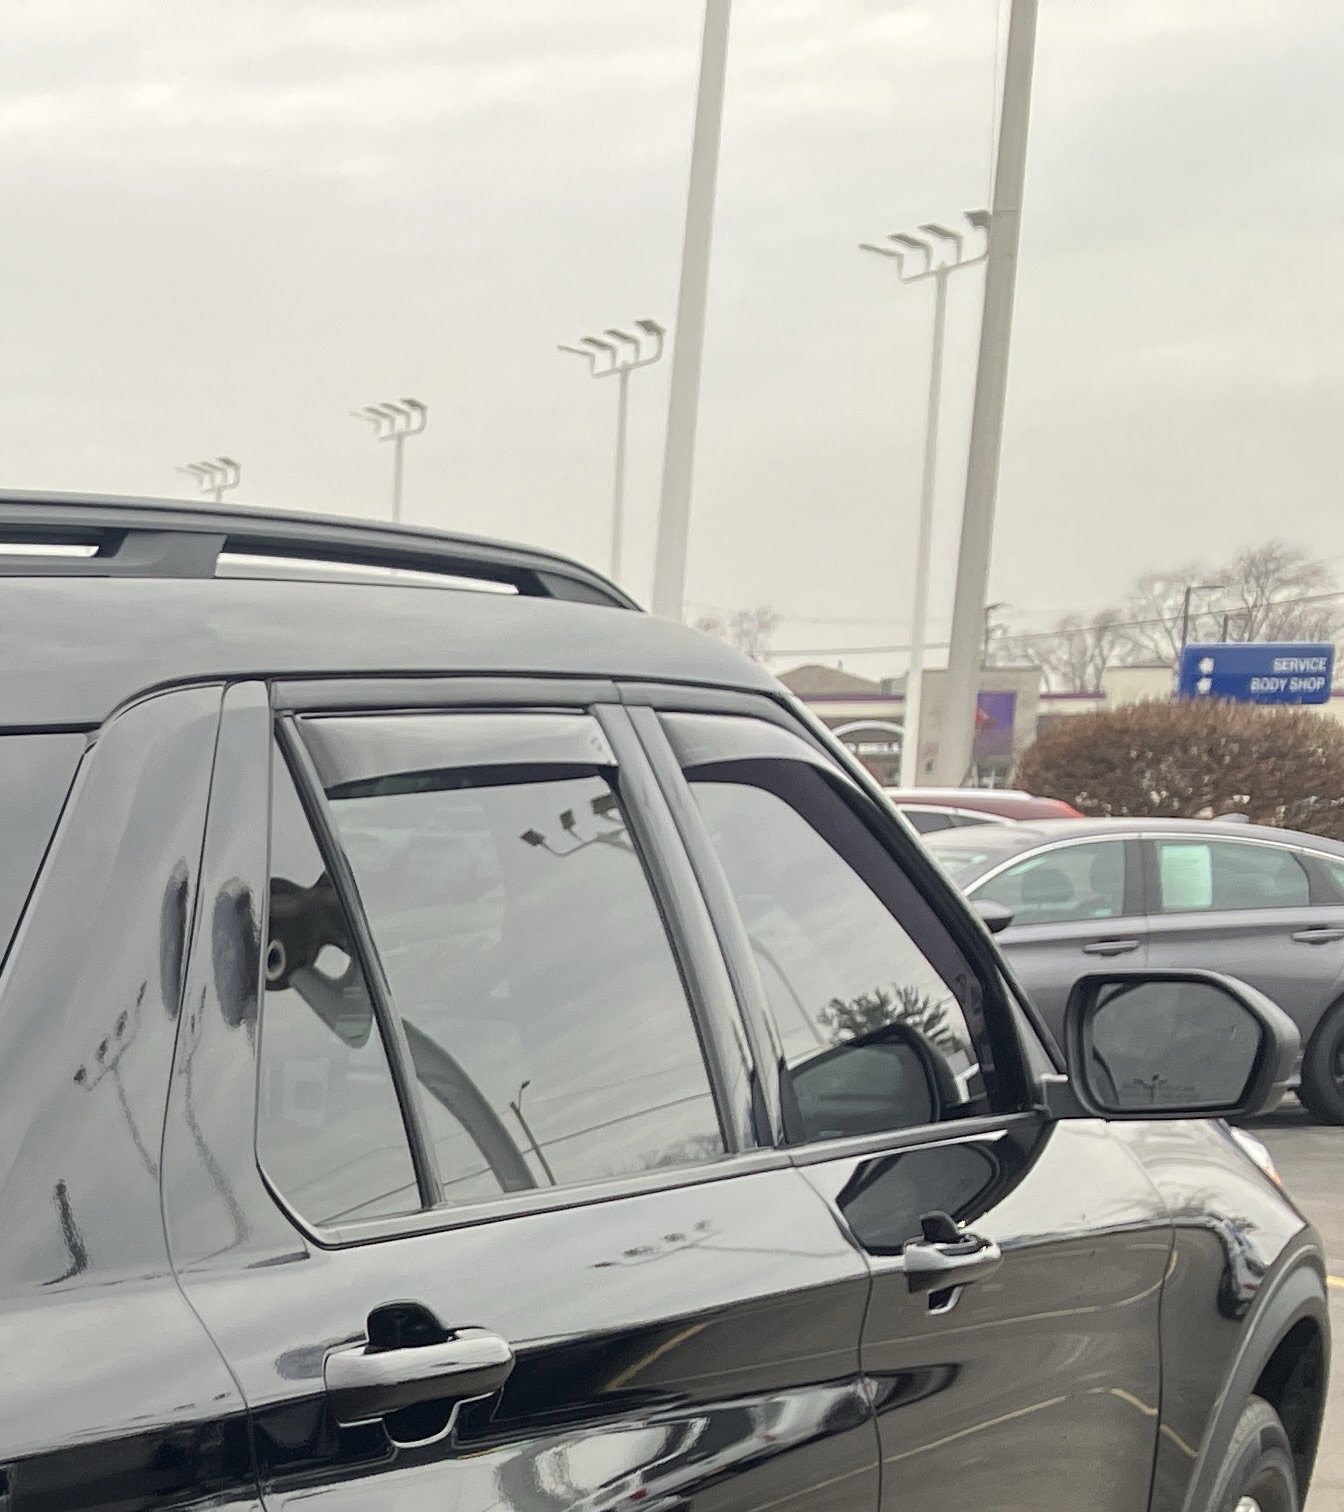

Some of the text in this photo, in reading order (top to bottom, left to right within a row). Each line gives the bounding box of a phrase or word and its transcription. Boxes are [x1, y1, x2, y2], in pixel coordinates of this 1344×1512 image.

[1273, 657, 1327, 672] SERVICE
[1251, 677, 1325, 692] BODY SHOP
